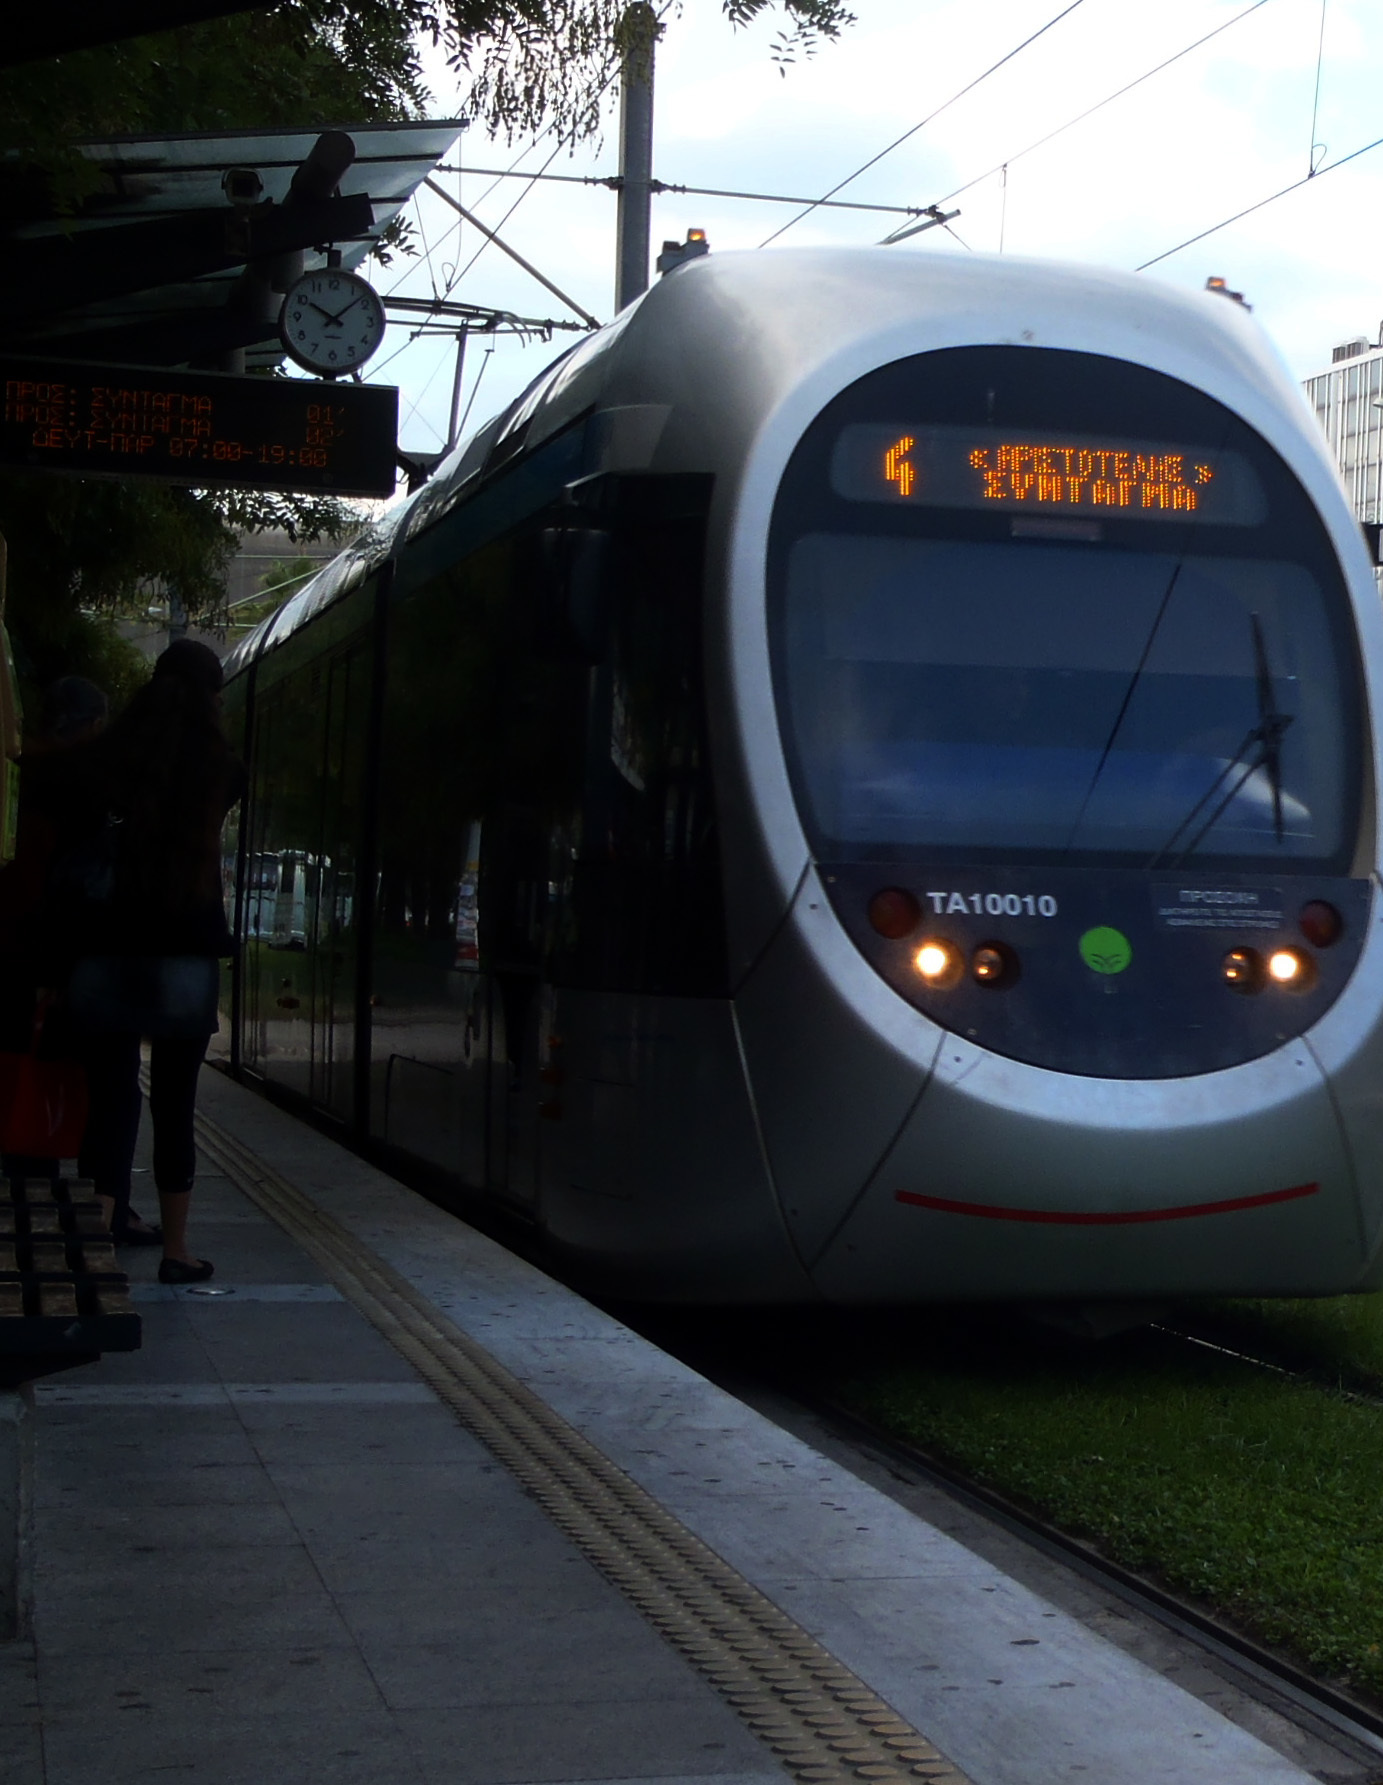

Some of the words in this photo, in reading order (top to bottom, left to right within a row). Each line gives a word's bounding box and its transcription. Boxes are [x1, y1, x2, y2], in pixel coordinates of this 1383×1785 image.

[311, 279, 322, 293] 11
[328, 279, 340, 290] 12
[350, 285, 355, 296] 1
[297, 294, 308, 305] 10
[361, 299, 370, 310] 2
[293, 311, 302, 322] 9
[367, 317, 374, 328] 3
[297, 330, 306, 341] 8
[361, 335, 369, 345] 4
[311, 343, 319, 354] 7
[347, 346, 355, 357] 5
[328, 350, 337, 361] 6
[168, 437, 328, 468] 07:00-19:00
[885, 437, 915, 497] 4
[925, 891, 1058, 917] TA10010
